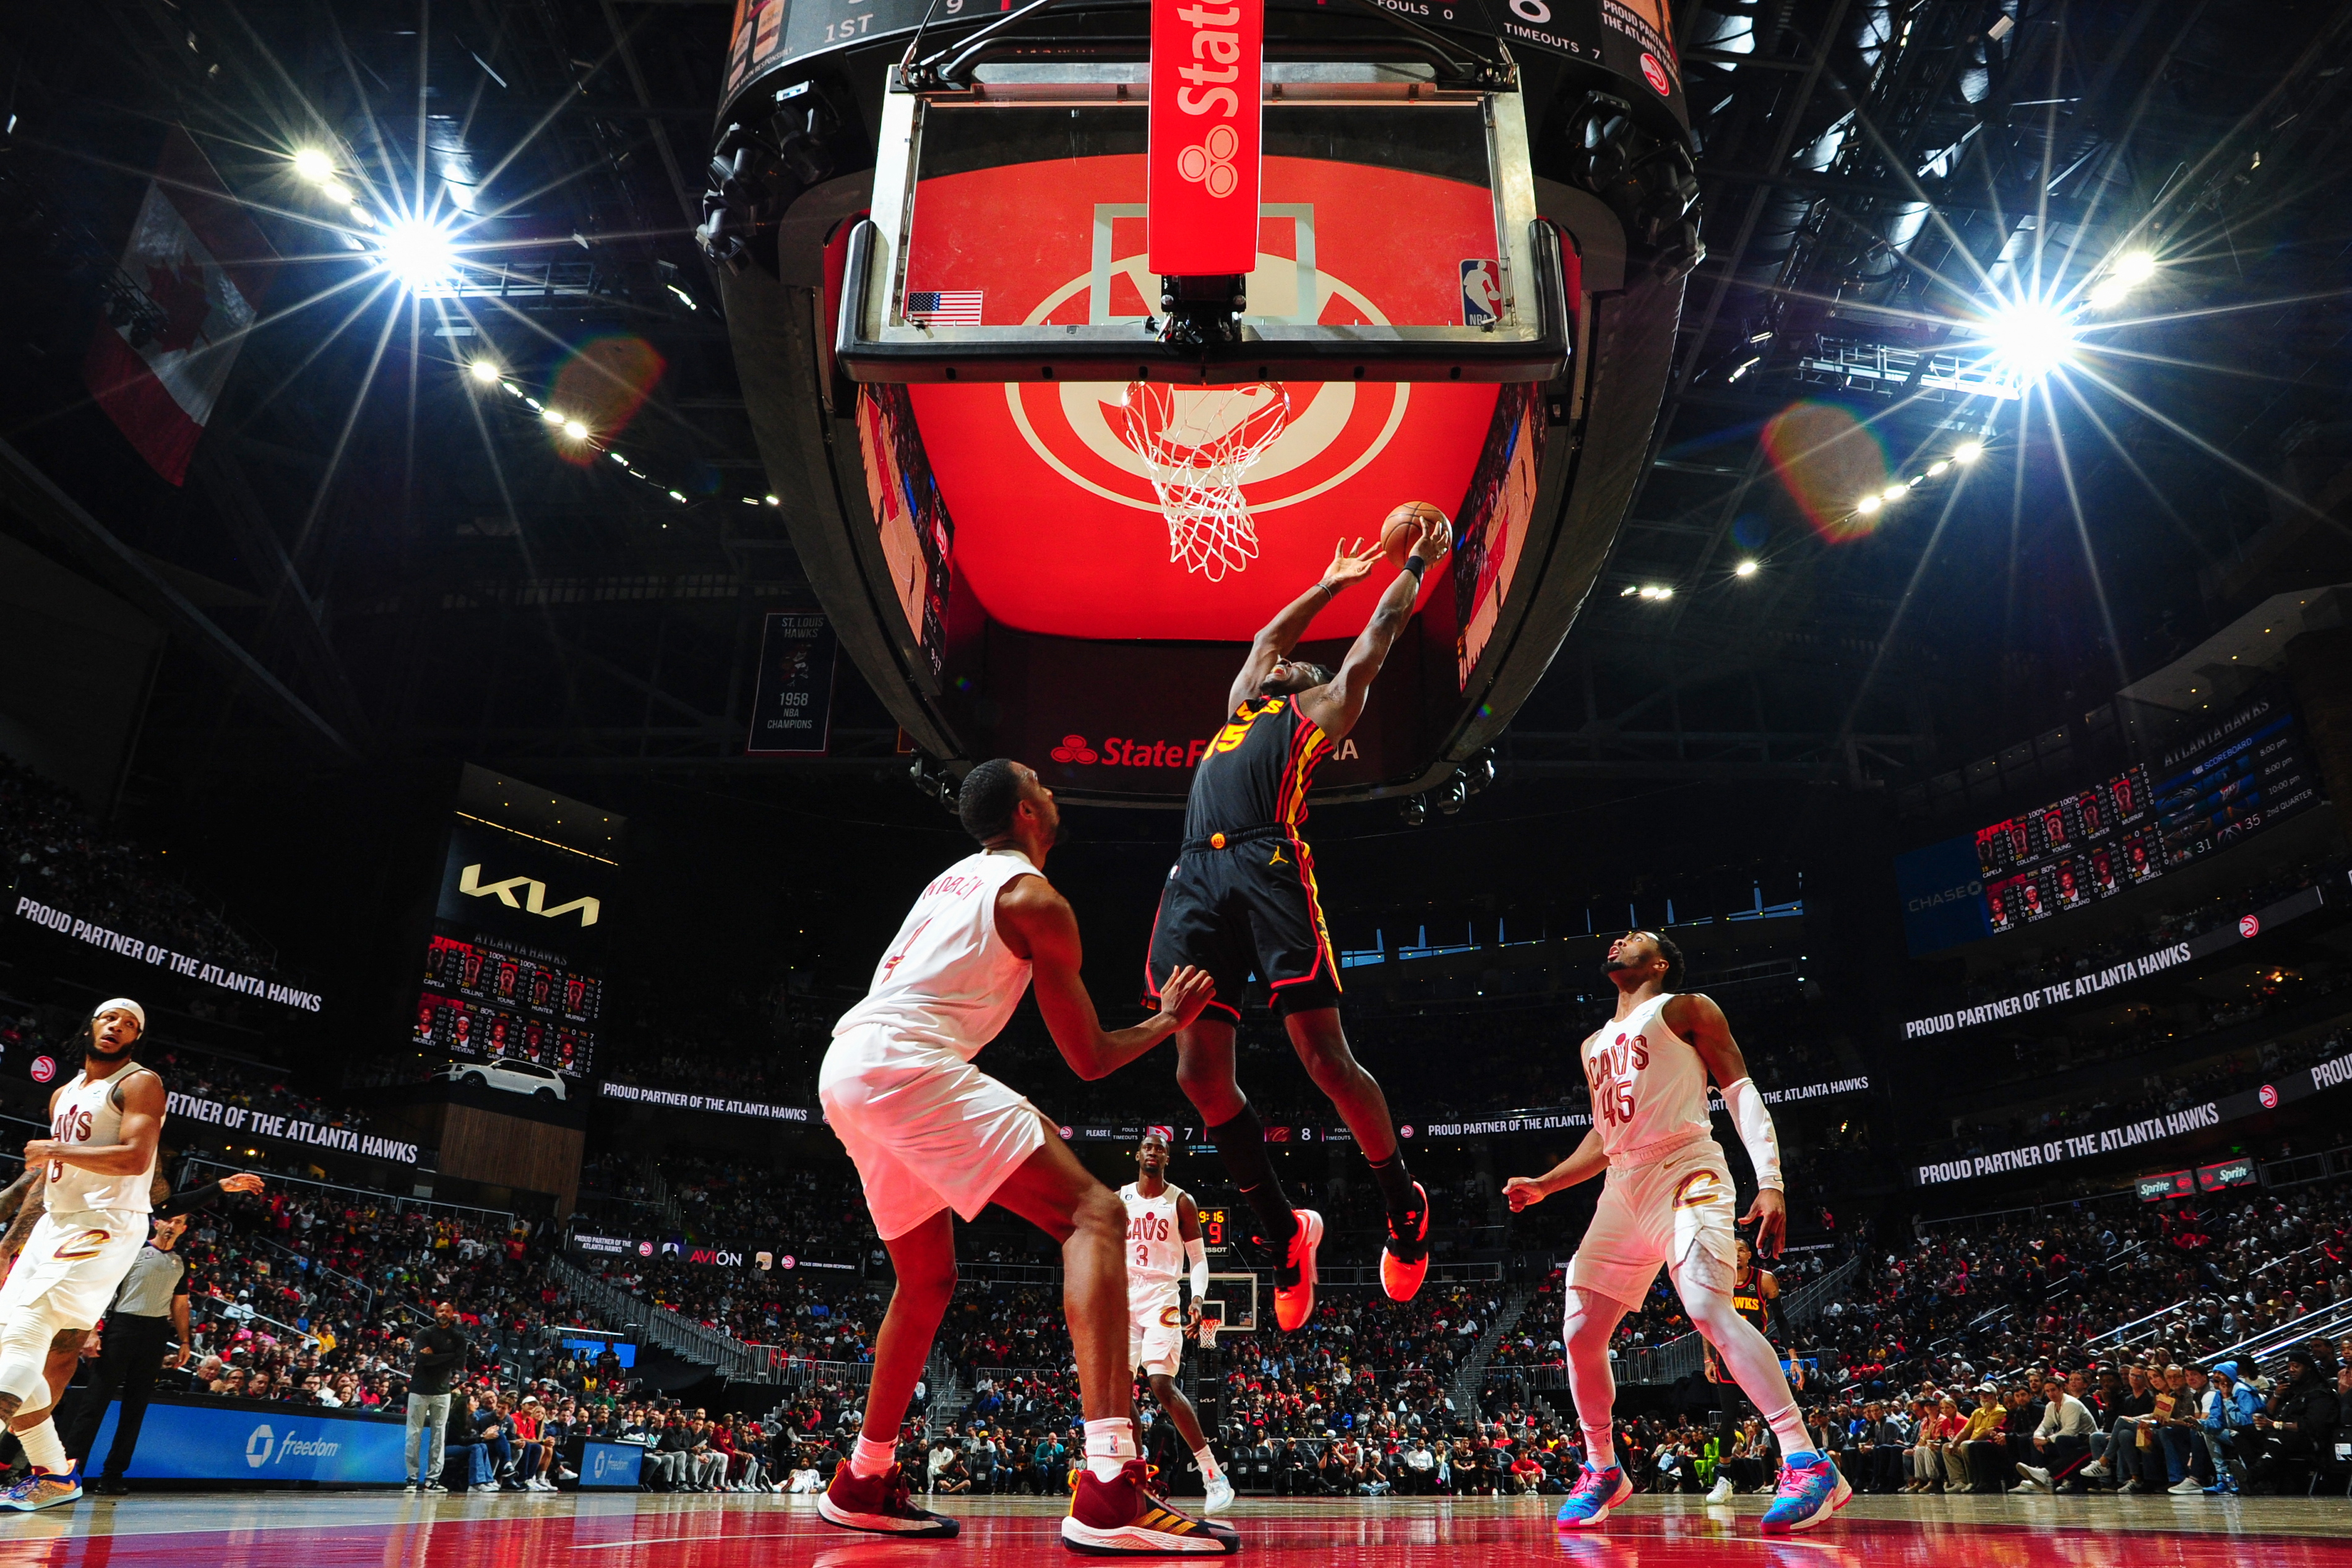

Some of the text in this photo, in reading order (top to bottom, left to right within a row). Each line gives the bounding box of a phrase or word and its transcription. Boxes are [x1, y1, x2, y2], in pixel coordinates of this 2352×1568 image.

[1377, 0, 1453, 20] FOULS 0
[1603, 0, 1638, 27] PROUD
[824, 14, 874, 43] 1ST
[1504, 22, 1600, 59] TIMEOUTS 7
[1601, 12, 1623, 32] THE
[1625, 25, 1661, 62] ATLANTA
[1177, 0, 1240, 118] Stat
[782, 617, 824, 627] ST. LOUIS
[785, 629, 819, 638] HAWKS
[780, 692, 809, 705] 1958
[783, 709, 799, 717] NBA
[767, 720, 813, 729] CHAMPIONS
[2204, 737, 2252, 770] SCOREBOARD
[2266, 788, 2313, 817] 2nd QUARTER
[2121, 812, 2144, 826] MURRAY
[2245, 814, 2261, 830] 35
[2088, 827, 2110, 840] HUNTER
[2052, 842, 2072, 853] YOUNG
[2196, 838, 2212, 854] 31
[2017, 854, 2039, 866] COLLINS
[1983, 868, 2002, 878] CAPELA
[2135, 870, 2163, 885] MITCHELL
[460, 864, 600, 927] KIA
[1909, 885, 1967, 911] CHASE
[2101, 886, 2120, 898] LEVERT
[2063, 898, 2090, 910] GARLAND
[2028, 910, 2052, 922] STEVENS
[1993, 923, 2014, 934] MOBLEY
[15, 897, 322, 1012] PROUD PARTNER OF THE ATLANTA HAWKS
[423, 978, 445, 988] CAPELA
[1906, 942, 2191, 1039] PROUD PARTNER OF THE ATLANTA HAWKS
[460, 988, 484, 997] COLLINS
[497, 996, 516, 1006] YOUNG
[532, 1005, 553, 1015] HUNTER
[565, 1013, 587, 1022] MURRAY
[413, 1036, 437, 1046] MOBLEY
[450, 1045, 476, 1055] STEVENS
[1588, 1034, 1650, 1091] CAVS
[556, 1067, 582, 1079] MITCHELL
[2311, 1053, 2352, 1090] PROU
[1762, 1077, 1869, 1105] THE ATLANTA HAWKS
[603, 1083, 808, 1121] PROUD PARTNER OF THE ATLANTA HAWKS
[1601, 1080, 1635, 1127] 45
[53, 1111, 92, 1142] AVS
[166, 1091, 418, 1164] RTNER OF THE ATLANTA HAWKS
[1428, 1124, 1461, 1136] PROUD
[1463, 1121, 1507, 1135] PARTNER
[1509, 1119, 1521, 1132] OF
[1522, 1118, 1542, 1131] THE
[1543, 1114, 1587, 1128] ATLANTA
[1184, 1127, 1194, 1140] 7
[1301, 1127, 1311, 1141] 8
[1919, 1102, 2220, 1184] PROUD PARTNER OF THE ATLANTA HAWKS
[2141, 1181, 2170, 1196] Sprite
[1208, 1222, 1222, 1244] 9
[574, 1234, 592, 1243] PROUD
[592, 1236, 614, 1245] PARTNER
[622, 1240, 632, 1248] THE
[582, 1243, 622, 1253] ATLANTA HAWKS
[1136, 1244, 1148, 1267] 3
[1732, 1296, 1759, 1311] WKS
[275, 1430, 338, 1464] freedom
